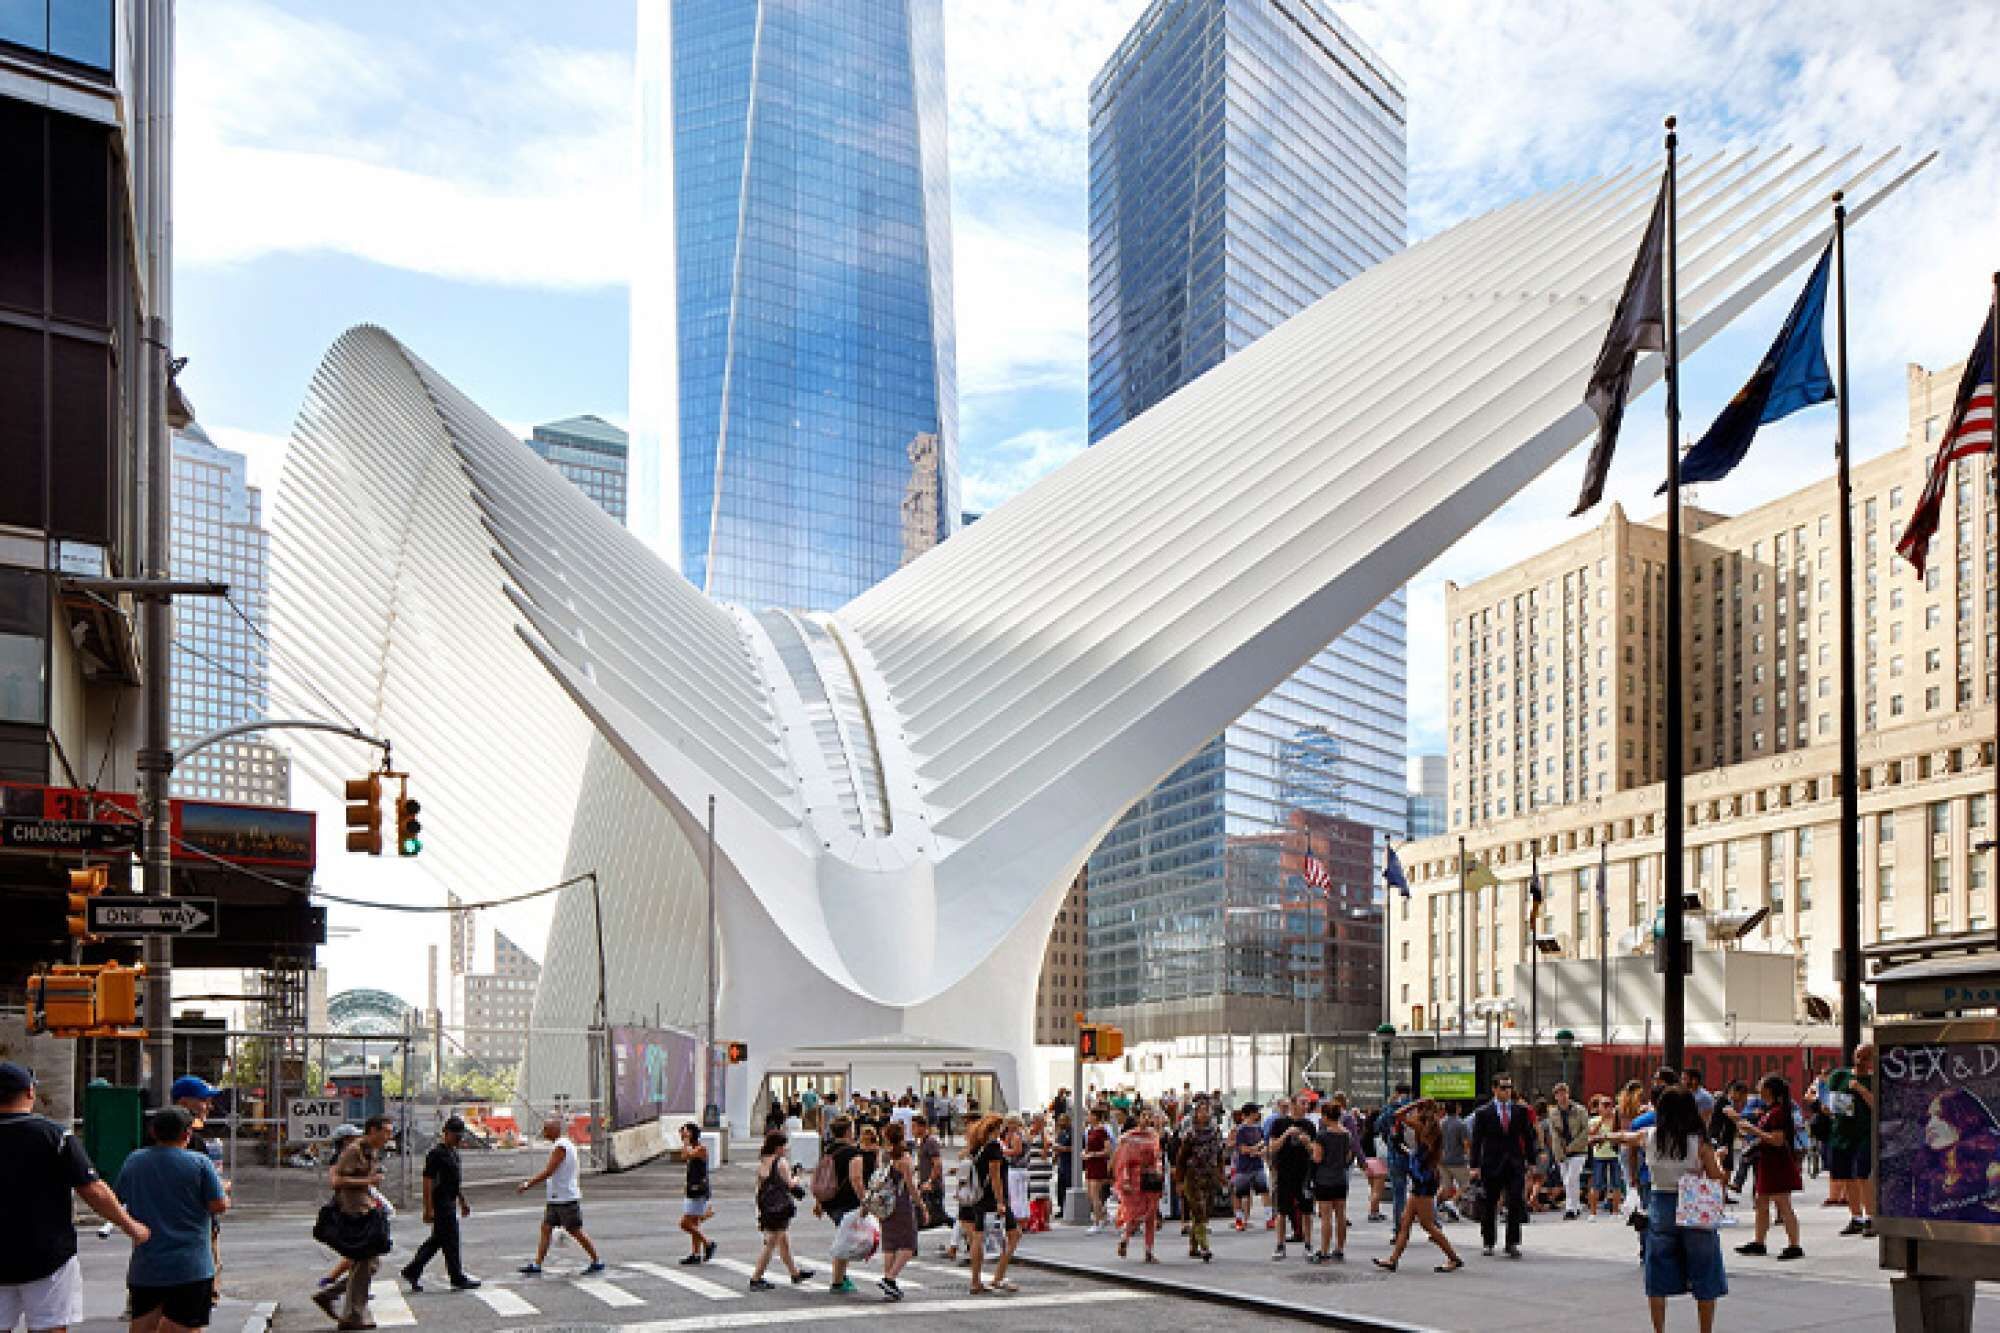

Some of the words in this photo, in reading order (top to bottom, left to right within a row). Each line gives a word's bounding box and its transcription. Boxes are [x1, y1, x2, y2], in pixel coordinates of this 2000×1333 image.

[13, 826, 81, 842] CHURCH
[106, 908, 144, 923] ONE
[160, 908, 197, 924] WAY
[1882, 1045, 1951, 1087] SEX
[1952, 1055, 1974, 1078] &
[293, 1101, 342, 1117] GATE
